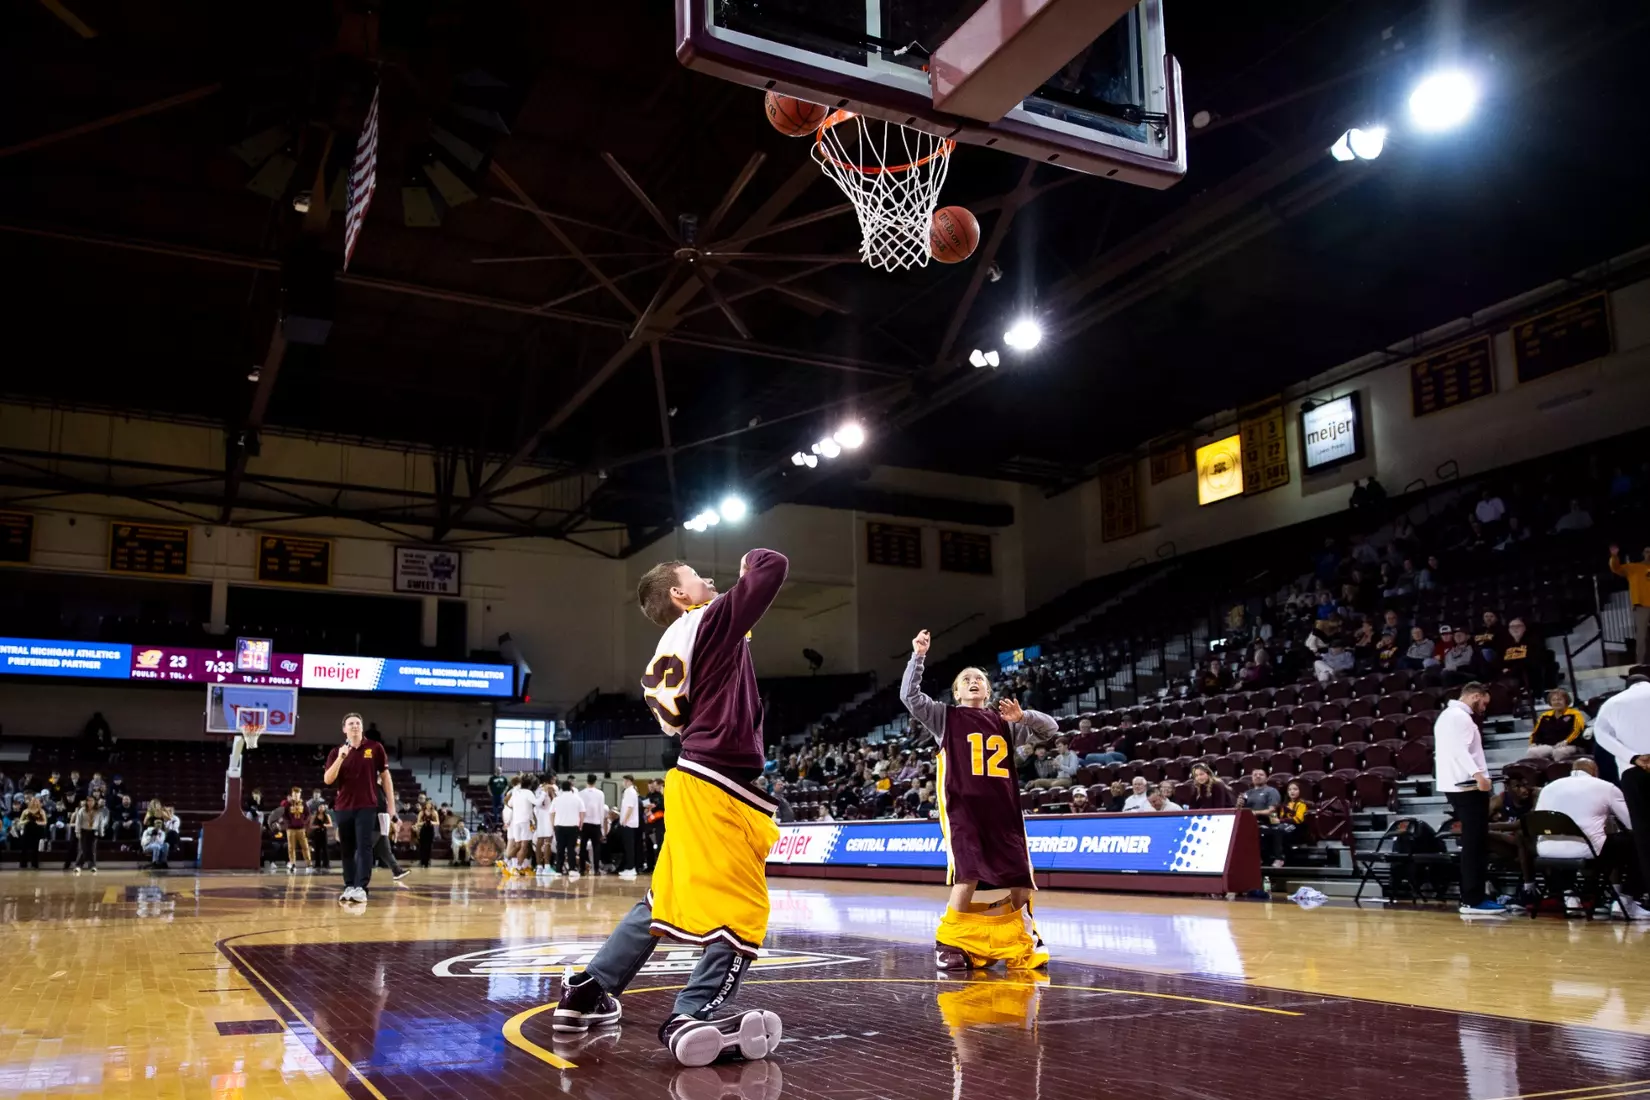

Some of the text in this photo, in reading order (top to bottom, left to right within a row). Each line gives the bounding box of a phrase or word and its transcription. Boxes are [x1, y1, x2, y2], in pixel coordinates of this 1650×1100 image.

[1307, 420, 1351, 445] meijer
[0, 645, 121, 659] NTRAL MICHIGAN ATHLETICS
[8, 657, 101, 669] PREFERRED PARTNER
[169, 655, 187, 668] 23
[205, 660, 234, 673] 7:33
[313, 662, 360, 682] meijer
[399, 666, 504, 679] CENTRAL MICHIGAN ATHLETICS
[414, 677, 489, 688] PREFERRED PARTNER
[967, 732, 1009, 778] 12
[845, 838, 885, 852] CENTRAL
[886, 837, 936, 852] MICHIGAN
[1027, 835, 1151, 853] FERRED PARTNER
[730, 956, 743, 972] ER
